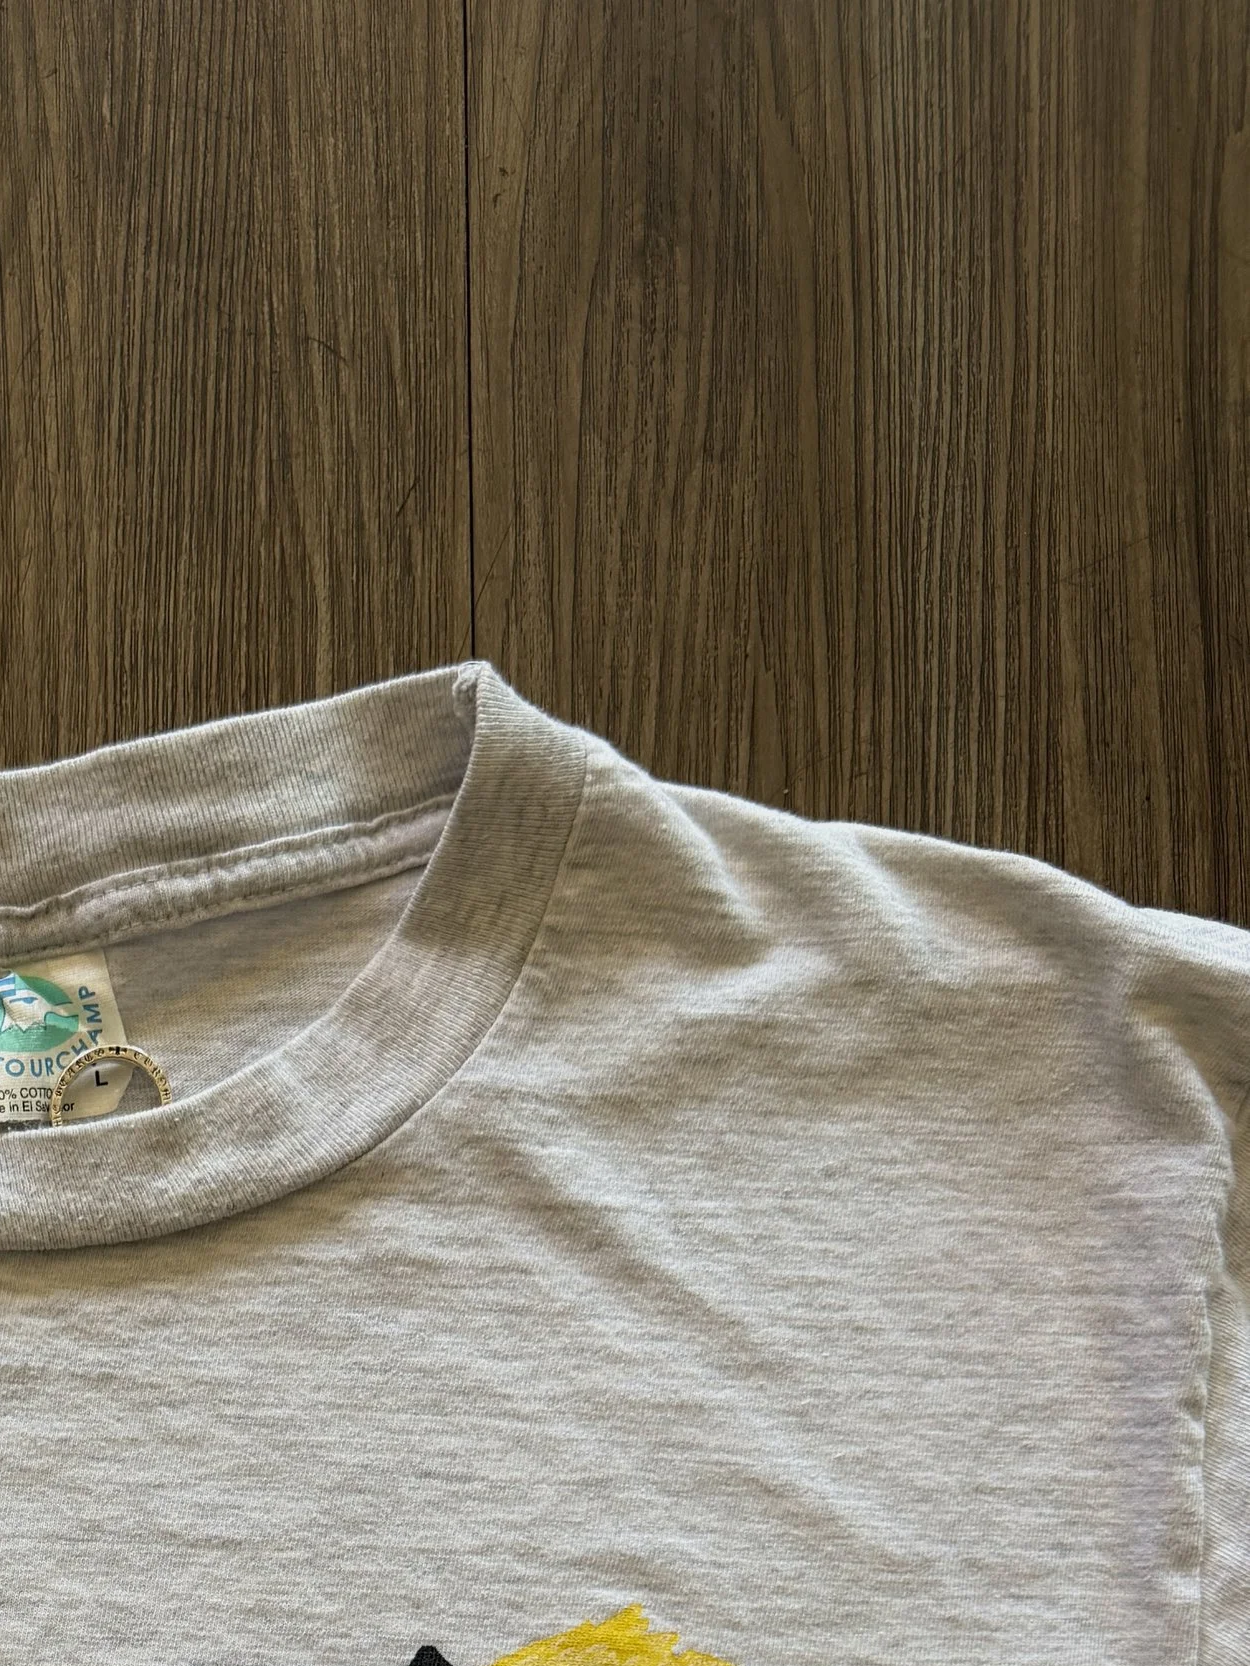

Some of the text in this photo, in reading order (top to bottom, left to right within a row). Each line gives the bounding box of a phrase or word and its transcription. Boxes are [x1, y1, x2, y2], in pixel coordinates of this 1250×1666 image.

[94, 1070, 108, 1087] L
[19, 1087, 53, 1100] COTTO
[9, 1102, 19, 1112] in
[22, 1101, 33, 1112] El
[35, 1100, 75, 1113] Salvor
